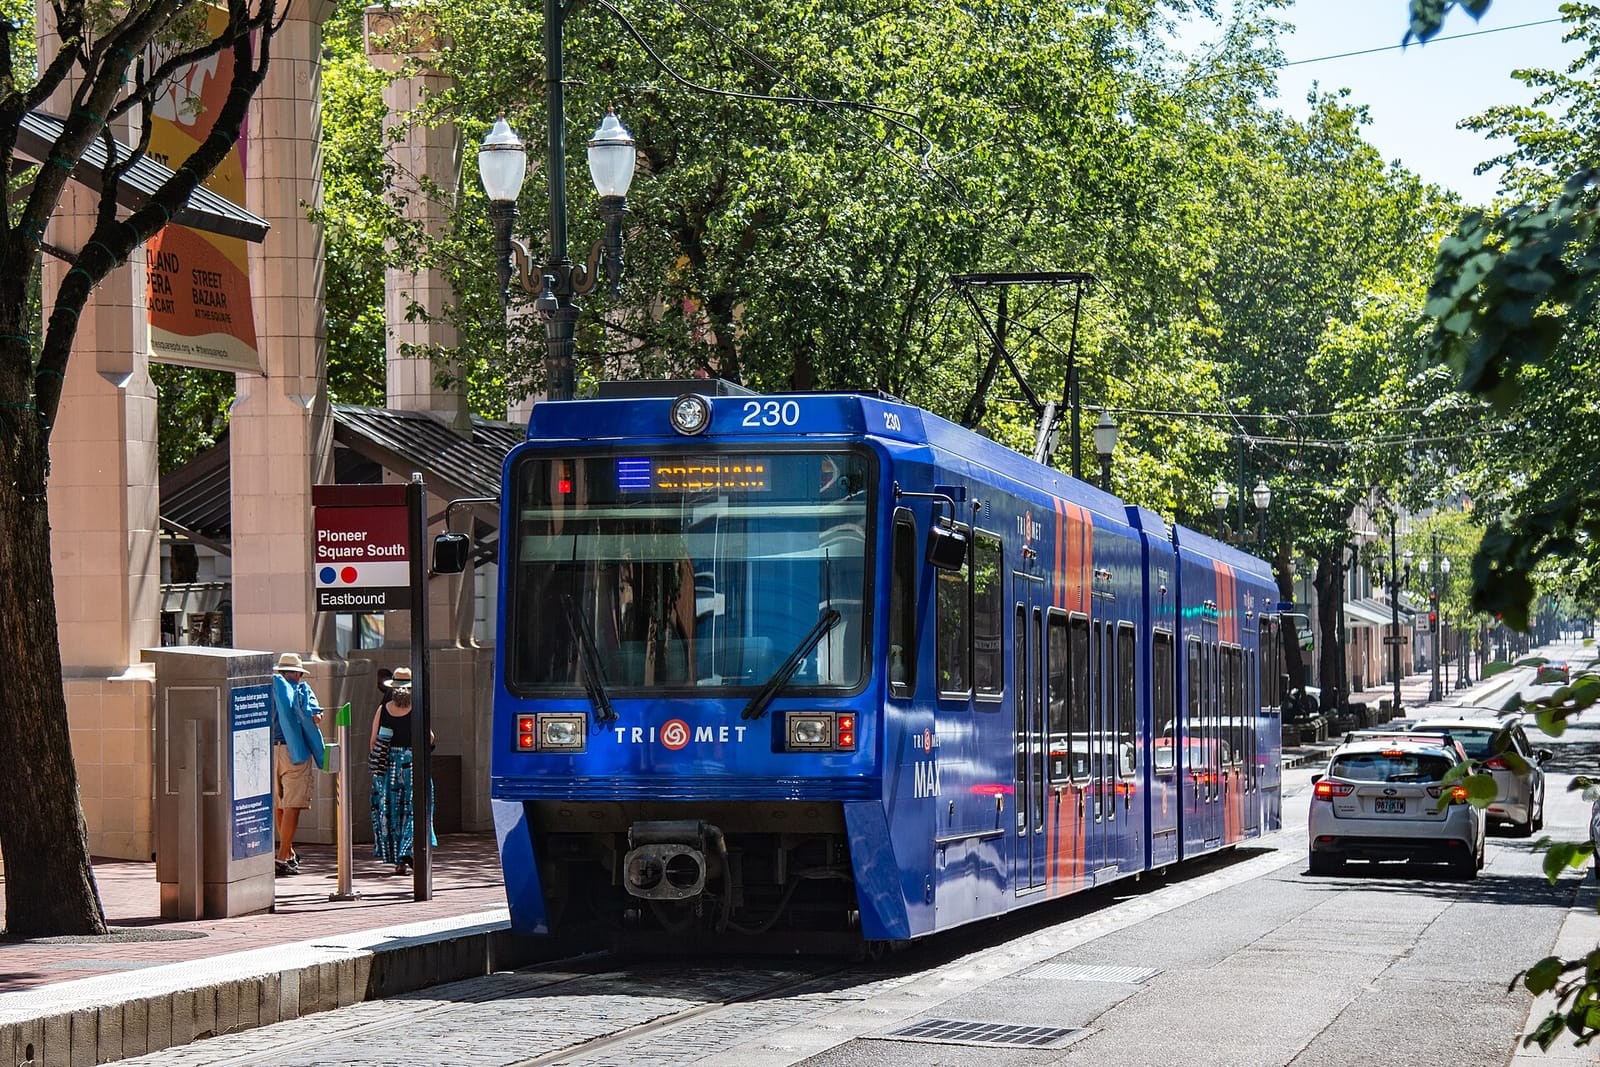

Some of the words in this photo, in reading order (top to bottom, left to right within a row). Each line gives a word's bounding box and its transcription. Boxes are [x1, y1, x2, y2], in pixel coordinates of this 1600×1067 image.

[192, 269, 222, 288] STREET
[192, 288, 228, 309] BAZAAR
[742, 400, 800, 427] 230
[883, 411, 901, 432] 230
[317, 529, 368, 542] Pioneer
[317, 545, 364, 560] Square
[367, 543, 405, 556] South
[320, 592, 386, 606] Eastbound
[614, 727, 655, 744] TRI
[694, 726, 747, 743] MET
[913, 734, 924, 749] TRI
[913, 760, 942, 799] MAX
